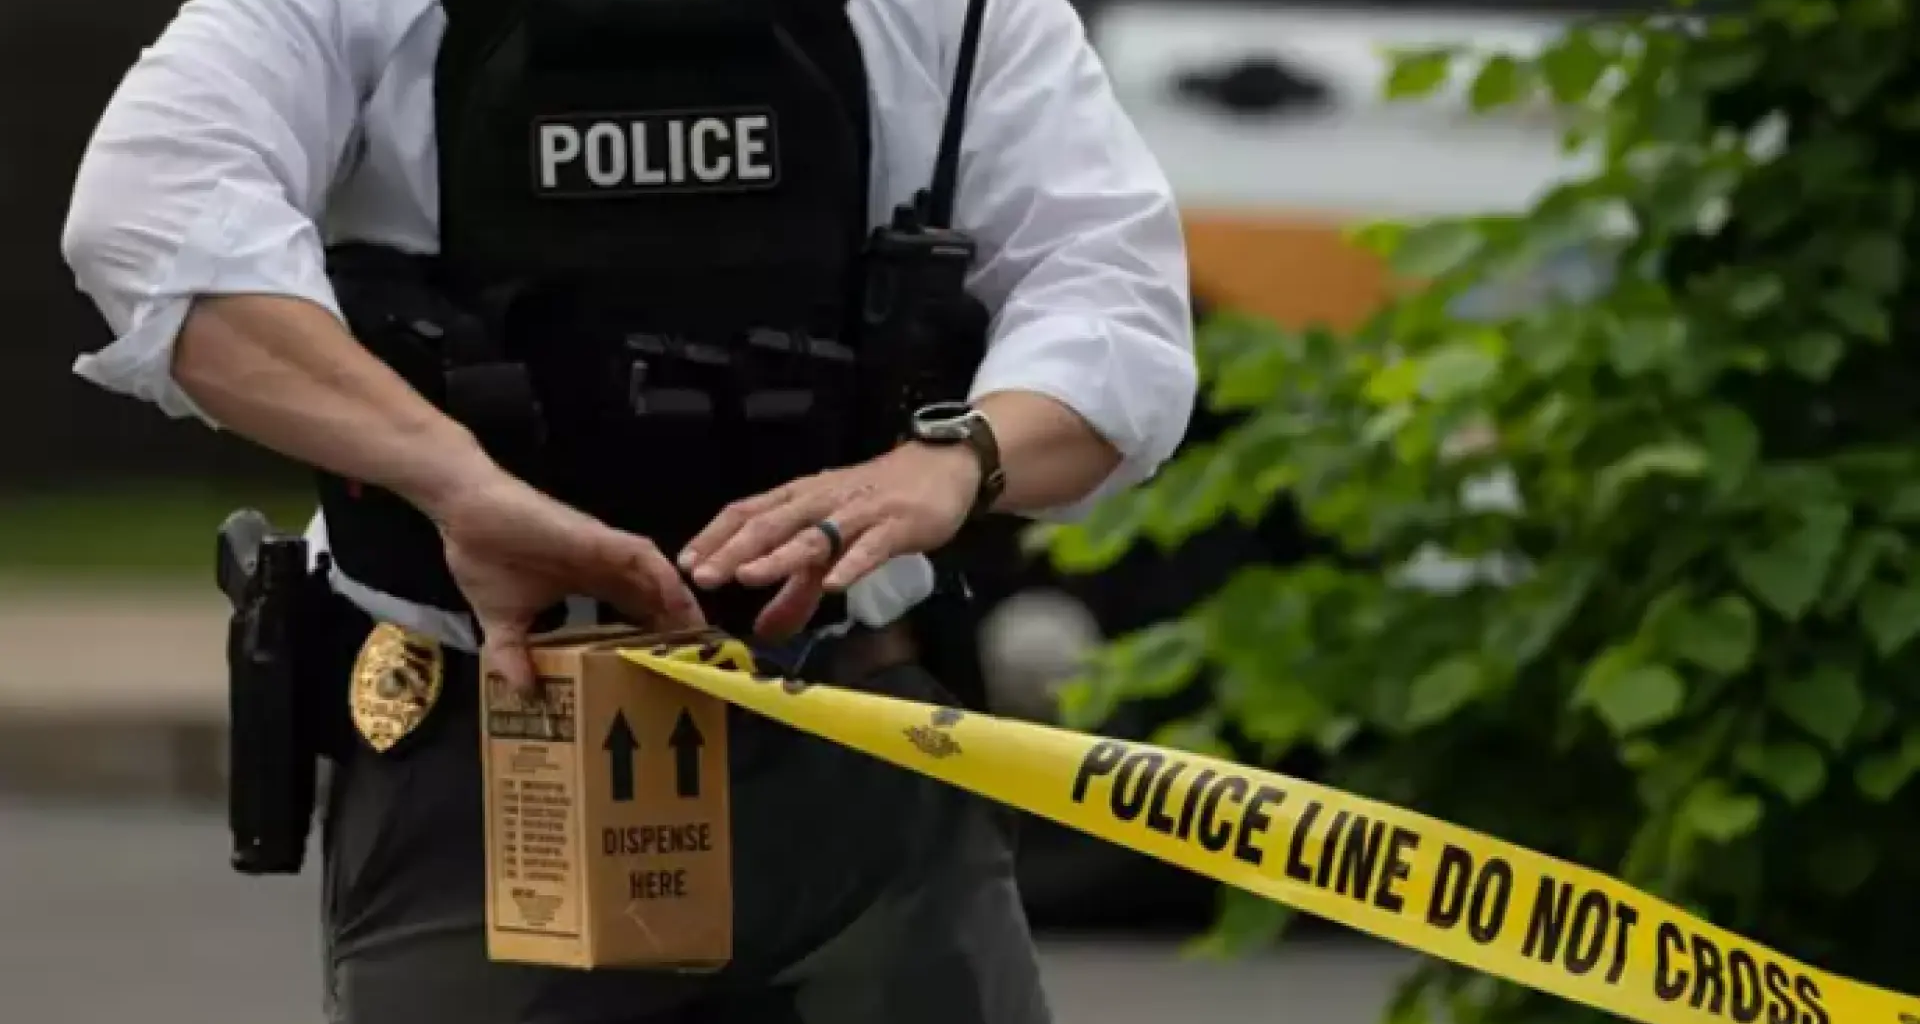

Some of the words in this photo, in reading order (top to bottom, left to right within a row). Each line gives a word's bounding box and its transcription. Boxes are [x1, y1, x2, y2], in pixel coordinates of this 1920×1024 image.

[540, 115, 772, 187] POLICE
[601, 823, 712, 855] DISPENSE
[629, 869, 688, 899] HERE
[1072, 740, 1286, 865] POLICE
[1285, 802, 1421, 913] LINE
[1427, 844, 1513, 944] DO
[1522, 875, 1638, 984] NOT
[1655, 921, 1831, 1024] CROSS
